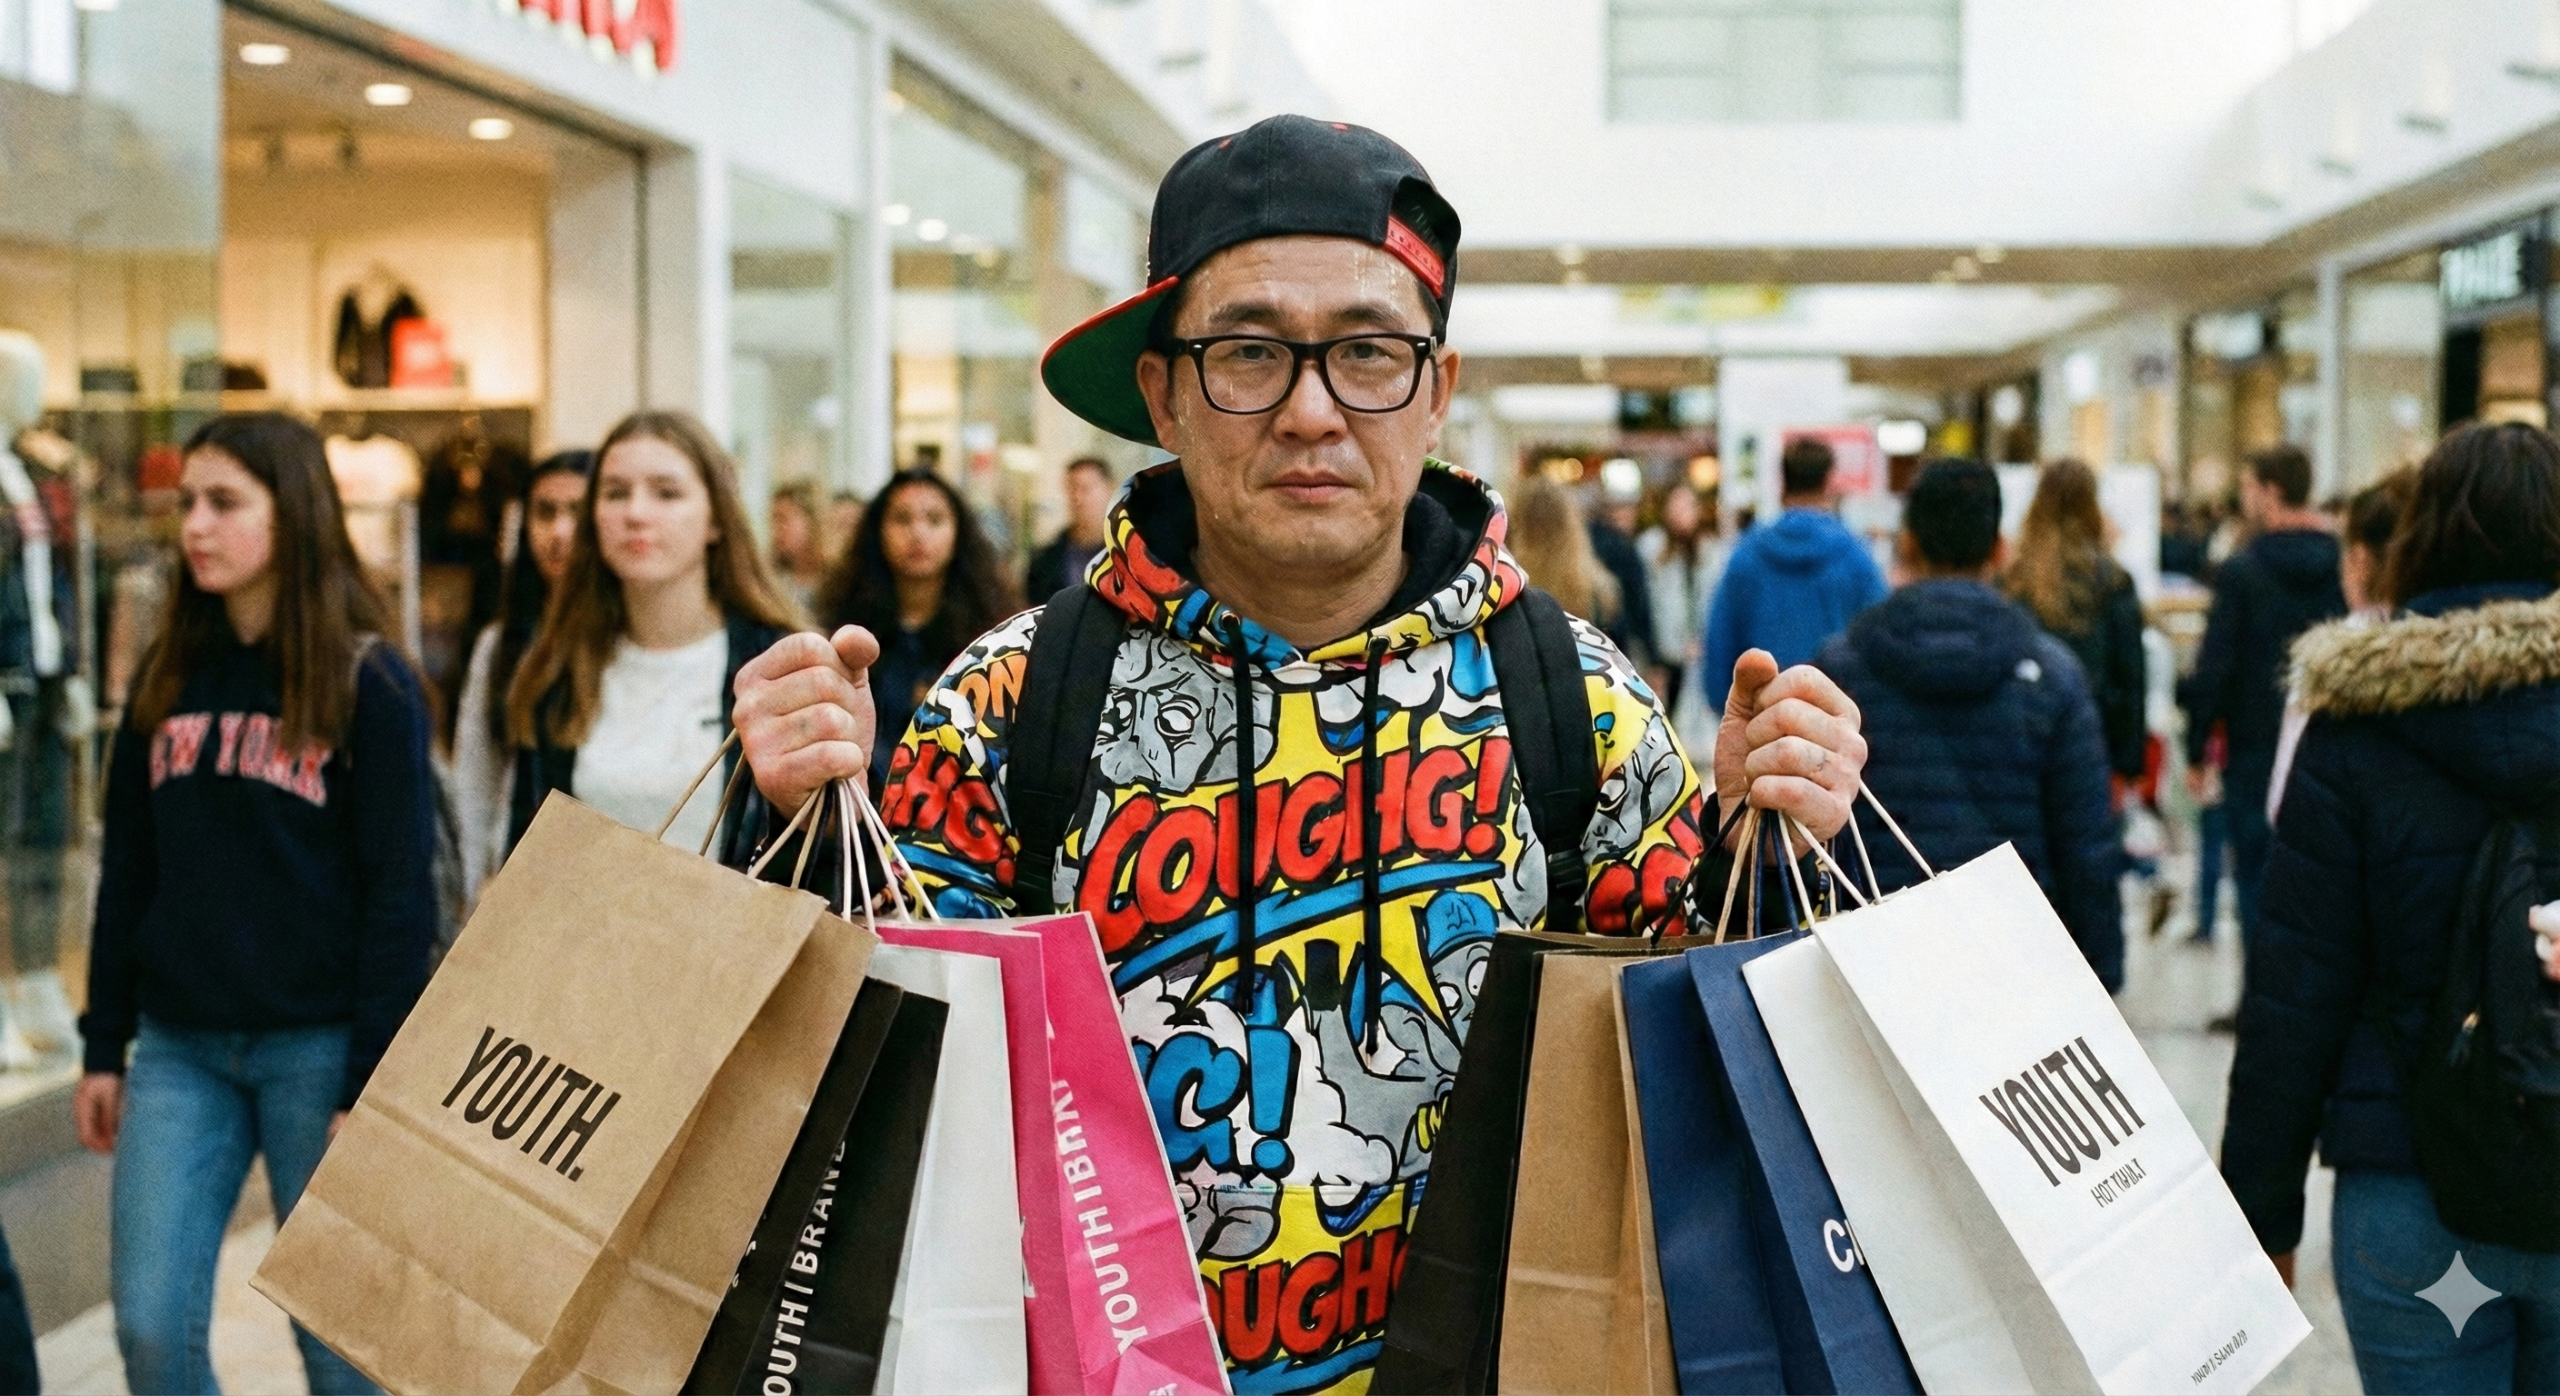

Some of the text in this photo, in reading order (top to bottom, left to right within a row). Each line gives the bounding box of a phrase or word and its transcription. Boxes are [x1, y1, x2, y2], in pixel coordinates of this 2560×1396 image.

[1078, 735, 1512, 953] COUGHG!
[441, 1025, 622, 1182] YOUTH.
[1978, 1036, 2146, 1187] YOUTH
[2090, 1179, 2118, 1208] HOT
[1078, 1205, 1148, 1356] YOUTH
[1208, 1230, 1411, 1362] UGH
